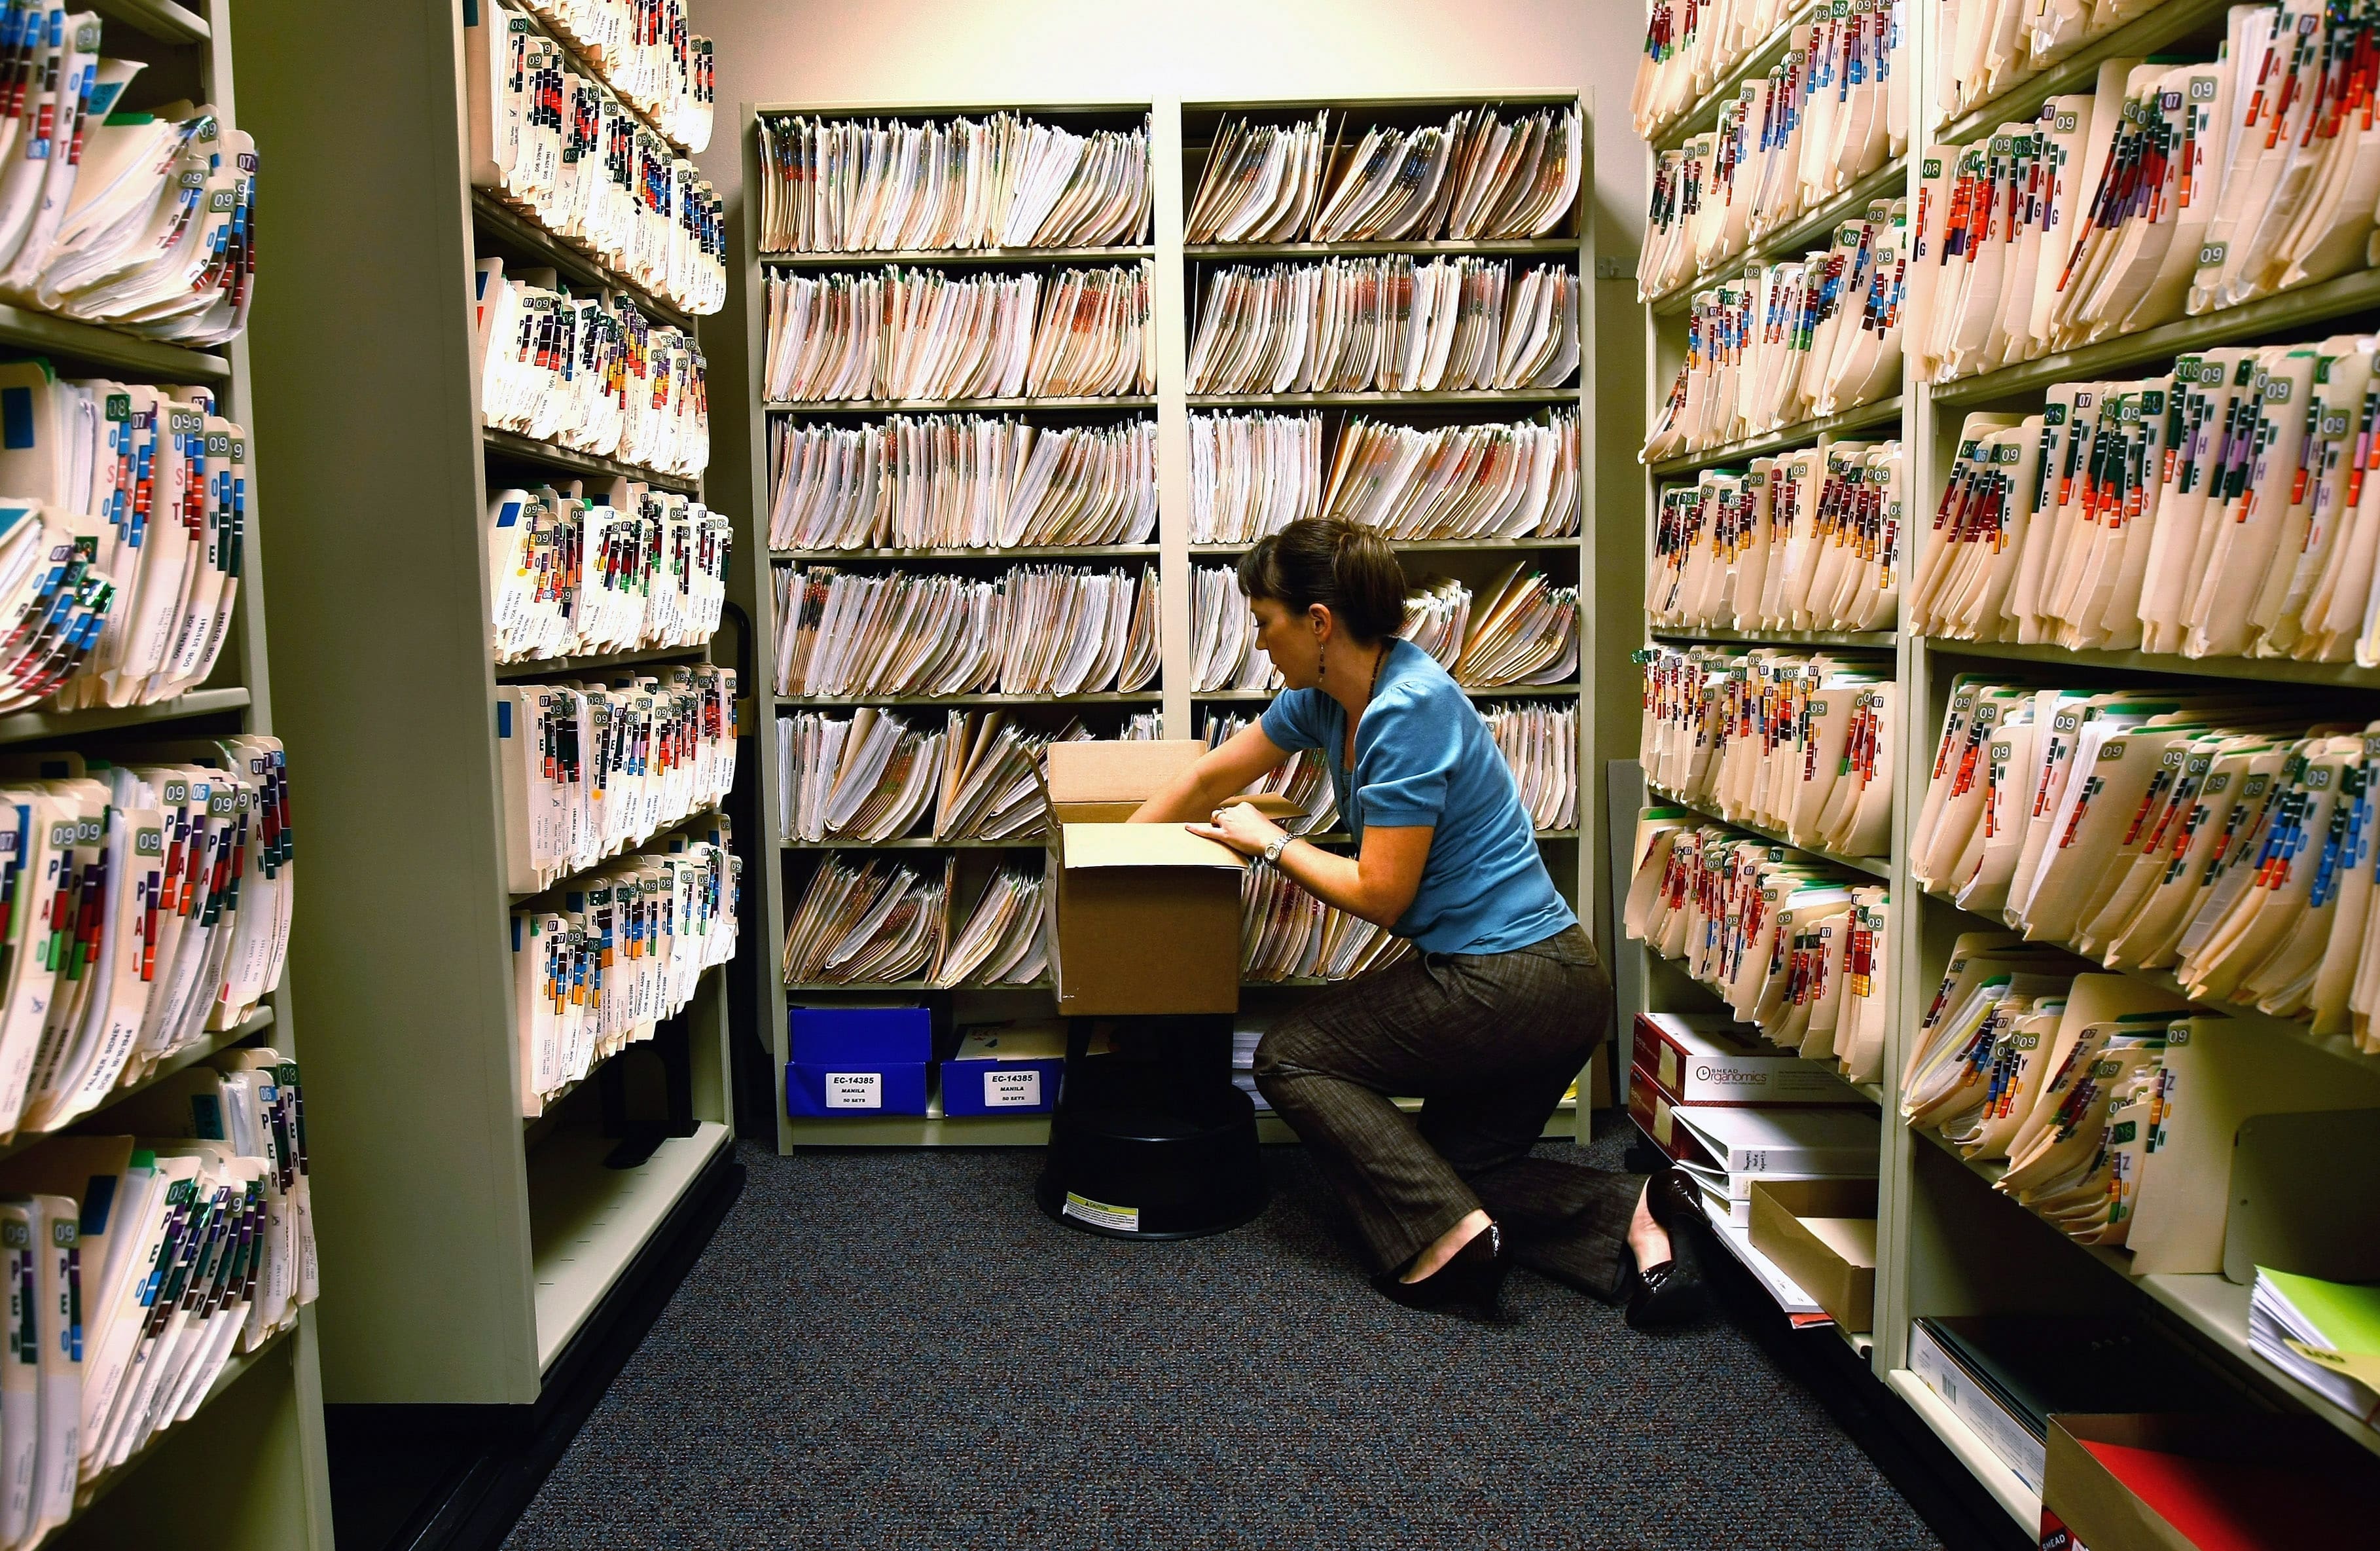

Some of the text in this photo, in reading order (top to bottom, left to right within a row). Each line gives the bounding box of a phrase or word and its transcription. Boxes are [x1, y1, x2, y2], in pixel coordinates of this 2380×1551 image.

[1857, 0, 1870, 10] 09
[1816, 10, 1828, 19] 09
[513, 21, 524, 30] 08
[513, 40, 518, 50] P
[528, 56, 541, 65] 09
[2191, 82, 2212, 97] 09
[2167, 94, 2180, 107] 07
[605, 104, 617, 113] 09
[2057, 116, 2074, 129] 09
[200, 124, 217, 137] 09
[637, 136, 647, 145] 09
[1996, 138, 2010, 151] 09
[1684, 147, 1693, 156] 09
[240, 156, 252, 169] 07
[1925, 162, 1939, 175] 08
[2019, 166, 2027, 180] W
[2051, 150, 2066, 224] W A G
[215, 192, 233, 208] 09
[1844, 233, 1857, 244] 08
[1877, 251, 1891, 261] 09
[536, 299, 548, 308] 09
[517, 320, 524, 345] P R
[2201, 367, 2222, 383] 09
[2267, 382, 2288, 399] 09
[2080, 394, 2091, 407] 07
[109, 399, 126, 417] 08
[2122, 407, 2139, 421] 09
[133, 416, 145, 428] 07
[171, 415, 190, 429] 09
[209, 436, 227, 452] 09
[2002, 448, 2018, 462] 09
[107, 465, 115, 483] S
[1875, 471, 1888, 481] 09
[2042, 434, 2058, 507] W E E
[1703, 487, 1713, 496] 09
[2143, 461, 2151, 509] E S
[2004, 481, 2013, 522] W E
[173, 503, 178, 520] T
[526, 505, 537, 514] 09
[209, 512, 218, 562] W E
[537, 534, 549, 543] 09
[173, 615, 195, 659] OWENS, JOE
[183, 618, 207, 666] DOB: 3/31/1941
[204, 611, 225, 663] DOB: 12/3/1946
[1788, 668, 1798, 678] 09
[541, 697, 549, 706] 07
[1875, 697, 1883, 706] 07
[1955, 697, 1970, 709] 09
[1811, 704, 1824, 713] 09
[1980, 706, 1995, 720] 09
[596, 714, 608, 723] 09
[2055, 717, 2075, 730] 09
[1793, 727, 1796, 737] R
[1874, 722, 1883, 776] V A L
[1992, 746, 2008, 759] 09
[2163, 752, 2182, 765] 09
[252, 760, 263, 773] 07
[167, 787, 185, 800] 09
[193, 786, 206, 799] 06
[213, 796, 232, 812] 09
[54, 829, 75, 844] 09
[139, 833, 160, 848] 09
[208, 835, 217, 852] P
[645, 883, 656, 891] 09
[1764, 891, 1776, 900] 09
[1778, 914, 1790, 922] 09
[1869, 918, 1883, 928] 09
[134, 881, 145, 972] P A L
[549, 921, 558, 930] 07
[569, 932, 580, 941] 09
[1822, 928, 1830, 937] 07
[1871, 937, 1879, 971] V A
[2021, 1036, 2036, 1048] 09
[2170, 1030, 2188, 1042] 09
[84, 1023, 120, 1091] PALMER, SIDNEY
[98, 1029, 132, 1089] DOB: 10/10/1946
[2021, 1057, 2027, 1071] Y
[283, 1067, 297, 1082] 08
[1697, 1066, 1766, 1084] Organomics
[261, 1088, 272, 1100] 06
[2157, 1075, 2175, 1146] Z N
[170, 1184, 187, 1199] 08
[149, 1213, 170, 1262] P E
[2042, 1534, 2065, 1551] SMEAD
